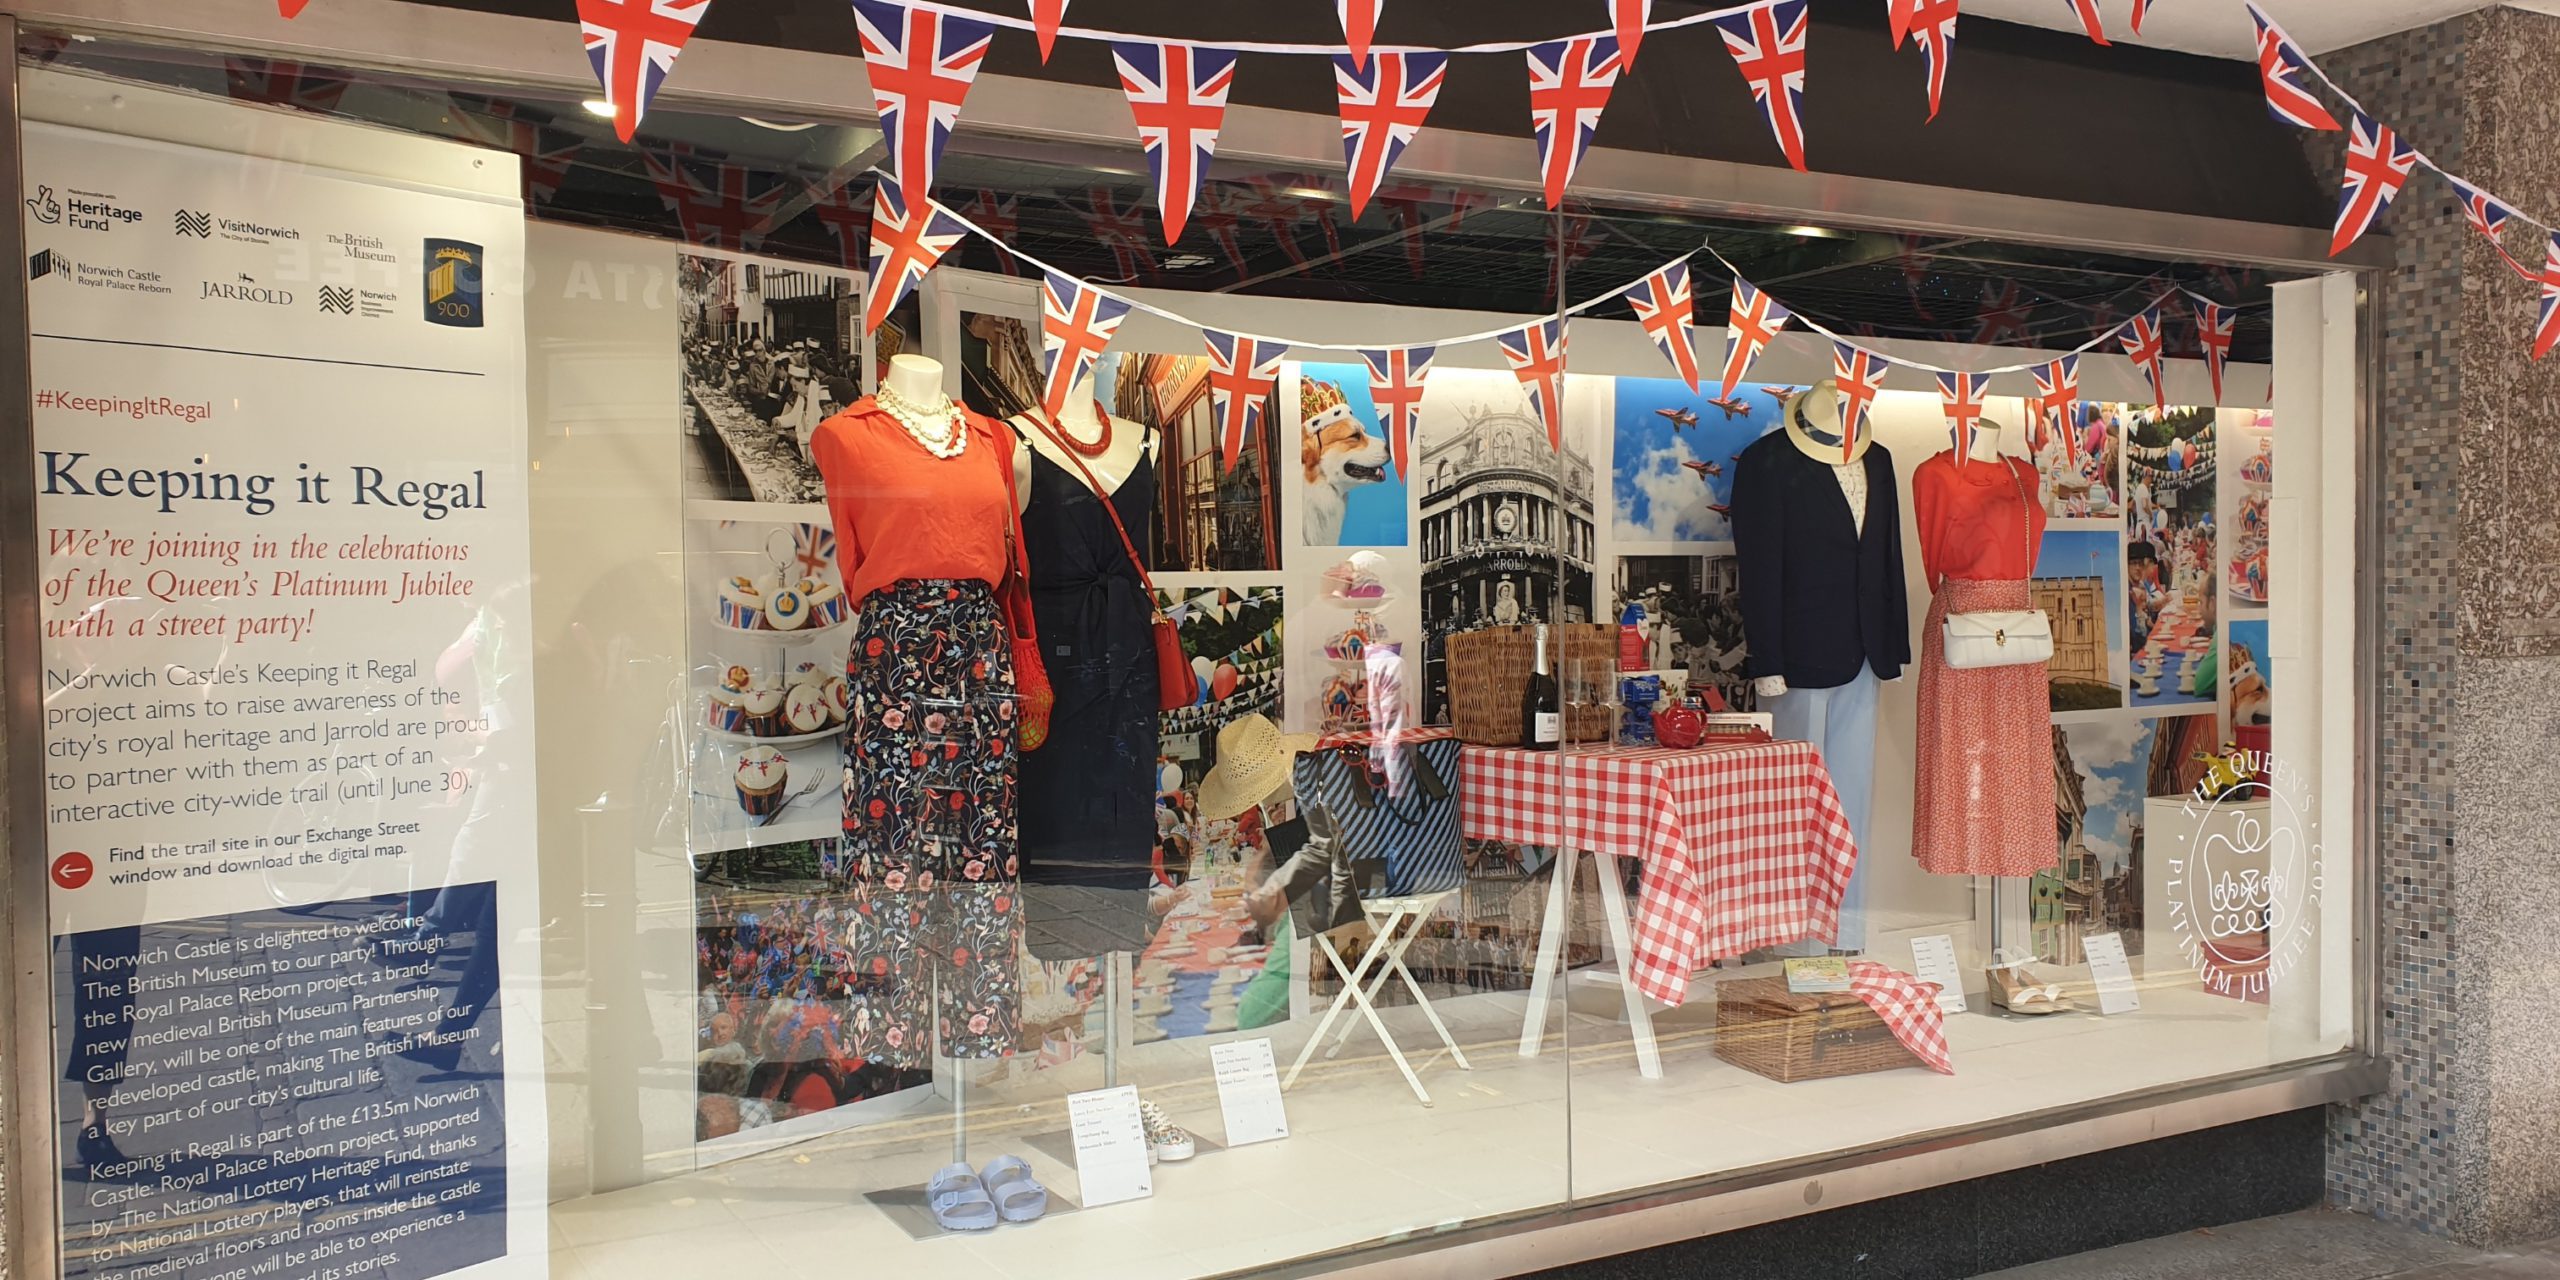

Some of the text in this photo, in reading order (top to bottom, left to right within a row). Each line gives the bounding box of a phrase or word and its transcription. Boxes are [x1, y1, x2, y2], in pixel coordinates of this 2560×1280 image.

[68, 199, 143, 223] Heritage
[69, 214, 109, 231] Fund
[218, 218, 299, 240] VisitNorwich
[326, 233, 383, 250] The British
[344, 246, 396, 264] Museum
[78, 263, 161, 282] Norwich Castle
[78, 276, 171, 294] Royal Palace Reborn
[200, 280, 293, 306] JARROLD
[360, 289, 396, 302] Norwich
[437, 301, 470, 318] 900
[36, 390, 211, 422] #KeepingItRegal
[40, 451, 486, 520] Keeping it Regal
[140, 532, 241, 566] joining
[252, 535, 277, 559] in
[290, 532, 327, 560] the
[338, 534, 468, 561] celebrations
[45, 568, 79, 605] of
[88, 568, 131, 597] the
[272, 570, 388, 597] Platinum
[392, 571, 473, 604] Jubilee
[46, 608, 314, 642] with a street party!
[48, 667, 156, 690] Norwich
[258, 663, 338, 687] Keeping
[347, 662, 359, 680] it
[368, 659, 416, 684] Regal
[49, 687, 461, 729] project aims to raise awareness of the
[118, 731, 173, 757] royal
[184, 729, 270, 751] heritage
[280, 723, 316, 743] and
[324, 720, 388, 744] Jarrold
[397, 723, 426, 736] are
[435, 714, 488, 739] proud
[49, 747, 432, 794] to partner with them as part of an
[51, 772, 472, 823] interactive city-wide trail (until June 30).
[2181, 765, 2222, 820] THE
[110, 822, 420, 863] Find the trail site in our Exchange Street
[110, 845, 406, 885] window and download the digital map.
[2167, 841, 2326, 1003] PLATINUM JUBILEE 2022
[83, 915, 424, 974] Norwich Castle is delighted to welcome
[83, 933, 444, 1000] The British Museum to our party! Through
[84, 959, 435, 1028] the Royal Palace Reborn project, a brand-
[86, 984, 439, 1055] new medieval British Museum Partnership
[87, 1006, 472, 1083] Gallery, will be one of the main features of our
[88, 1029, 479, 1111] redeveloped castle, making The British Museum
[88, 1126, 98, 1138] a
[106, 1117, 137, 1135] key
[144, 1107, 182, 1132] part
[188, 1100, 207, 1118] of
[212, 1098, 242, 1114] our
[294, 1072, 352, 1098] cultural
[358, 1069, 383, 1086] life.
[91, 1085, 479, 1180] Keeping it Regal is part of the £13.5m Norwich
